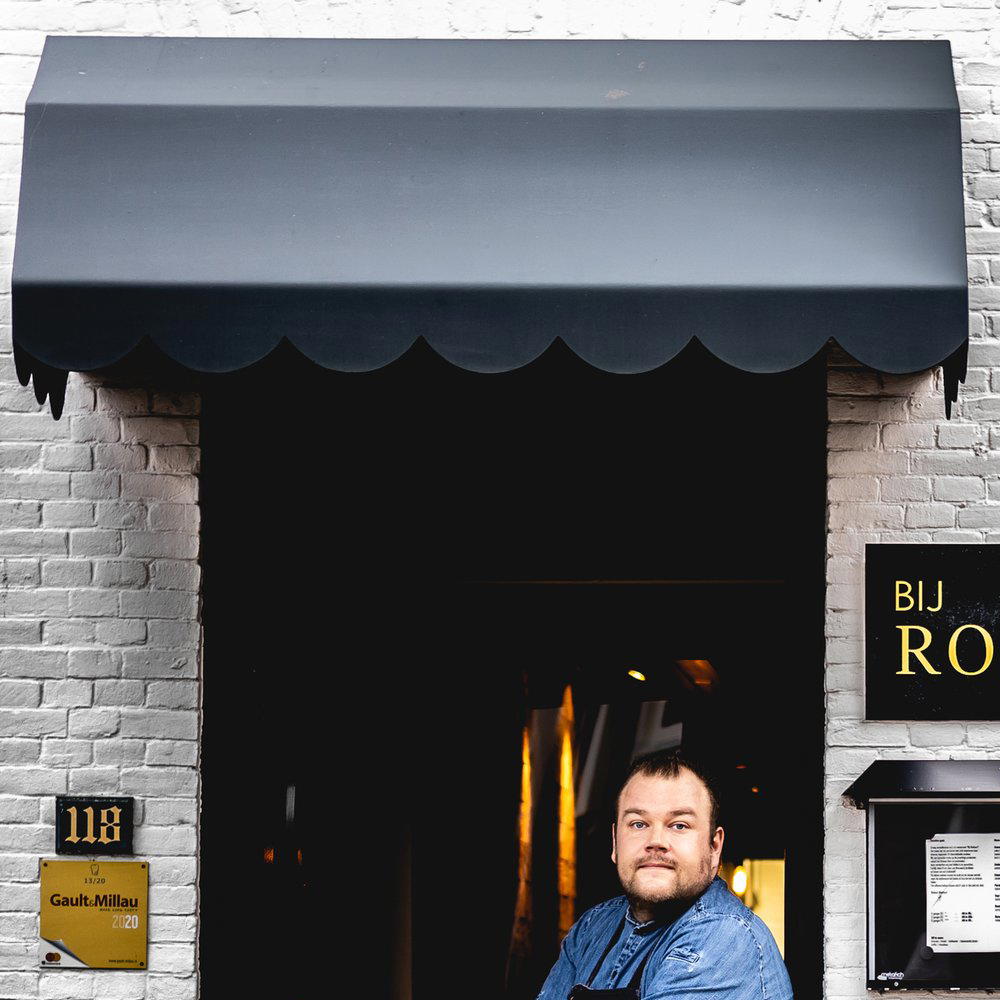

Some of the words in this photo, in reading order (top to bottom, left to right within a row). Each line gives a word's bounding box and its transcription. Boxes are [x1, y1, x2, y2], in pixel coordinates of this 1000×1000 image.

[895, 580, 943, 612] BIJ
[64, 805, 122, 844] 118
[112, 914, 139, 929] 2020
